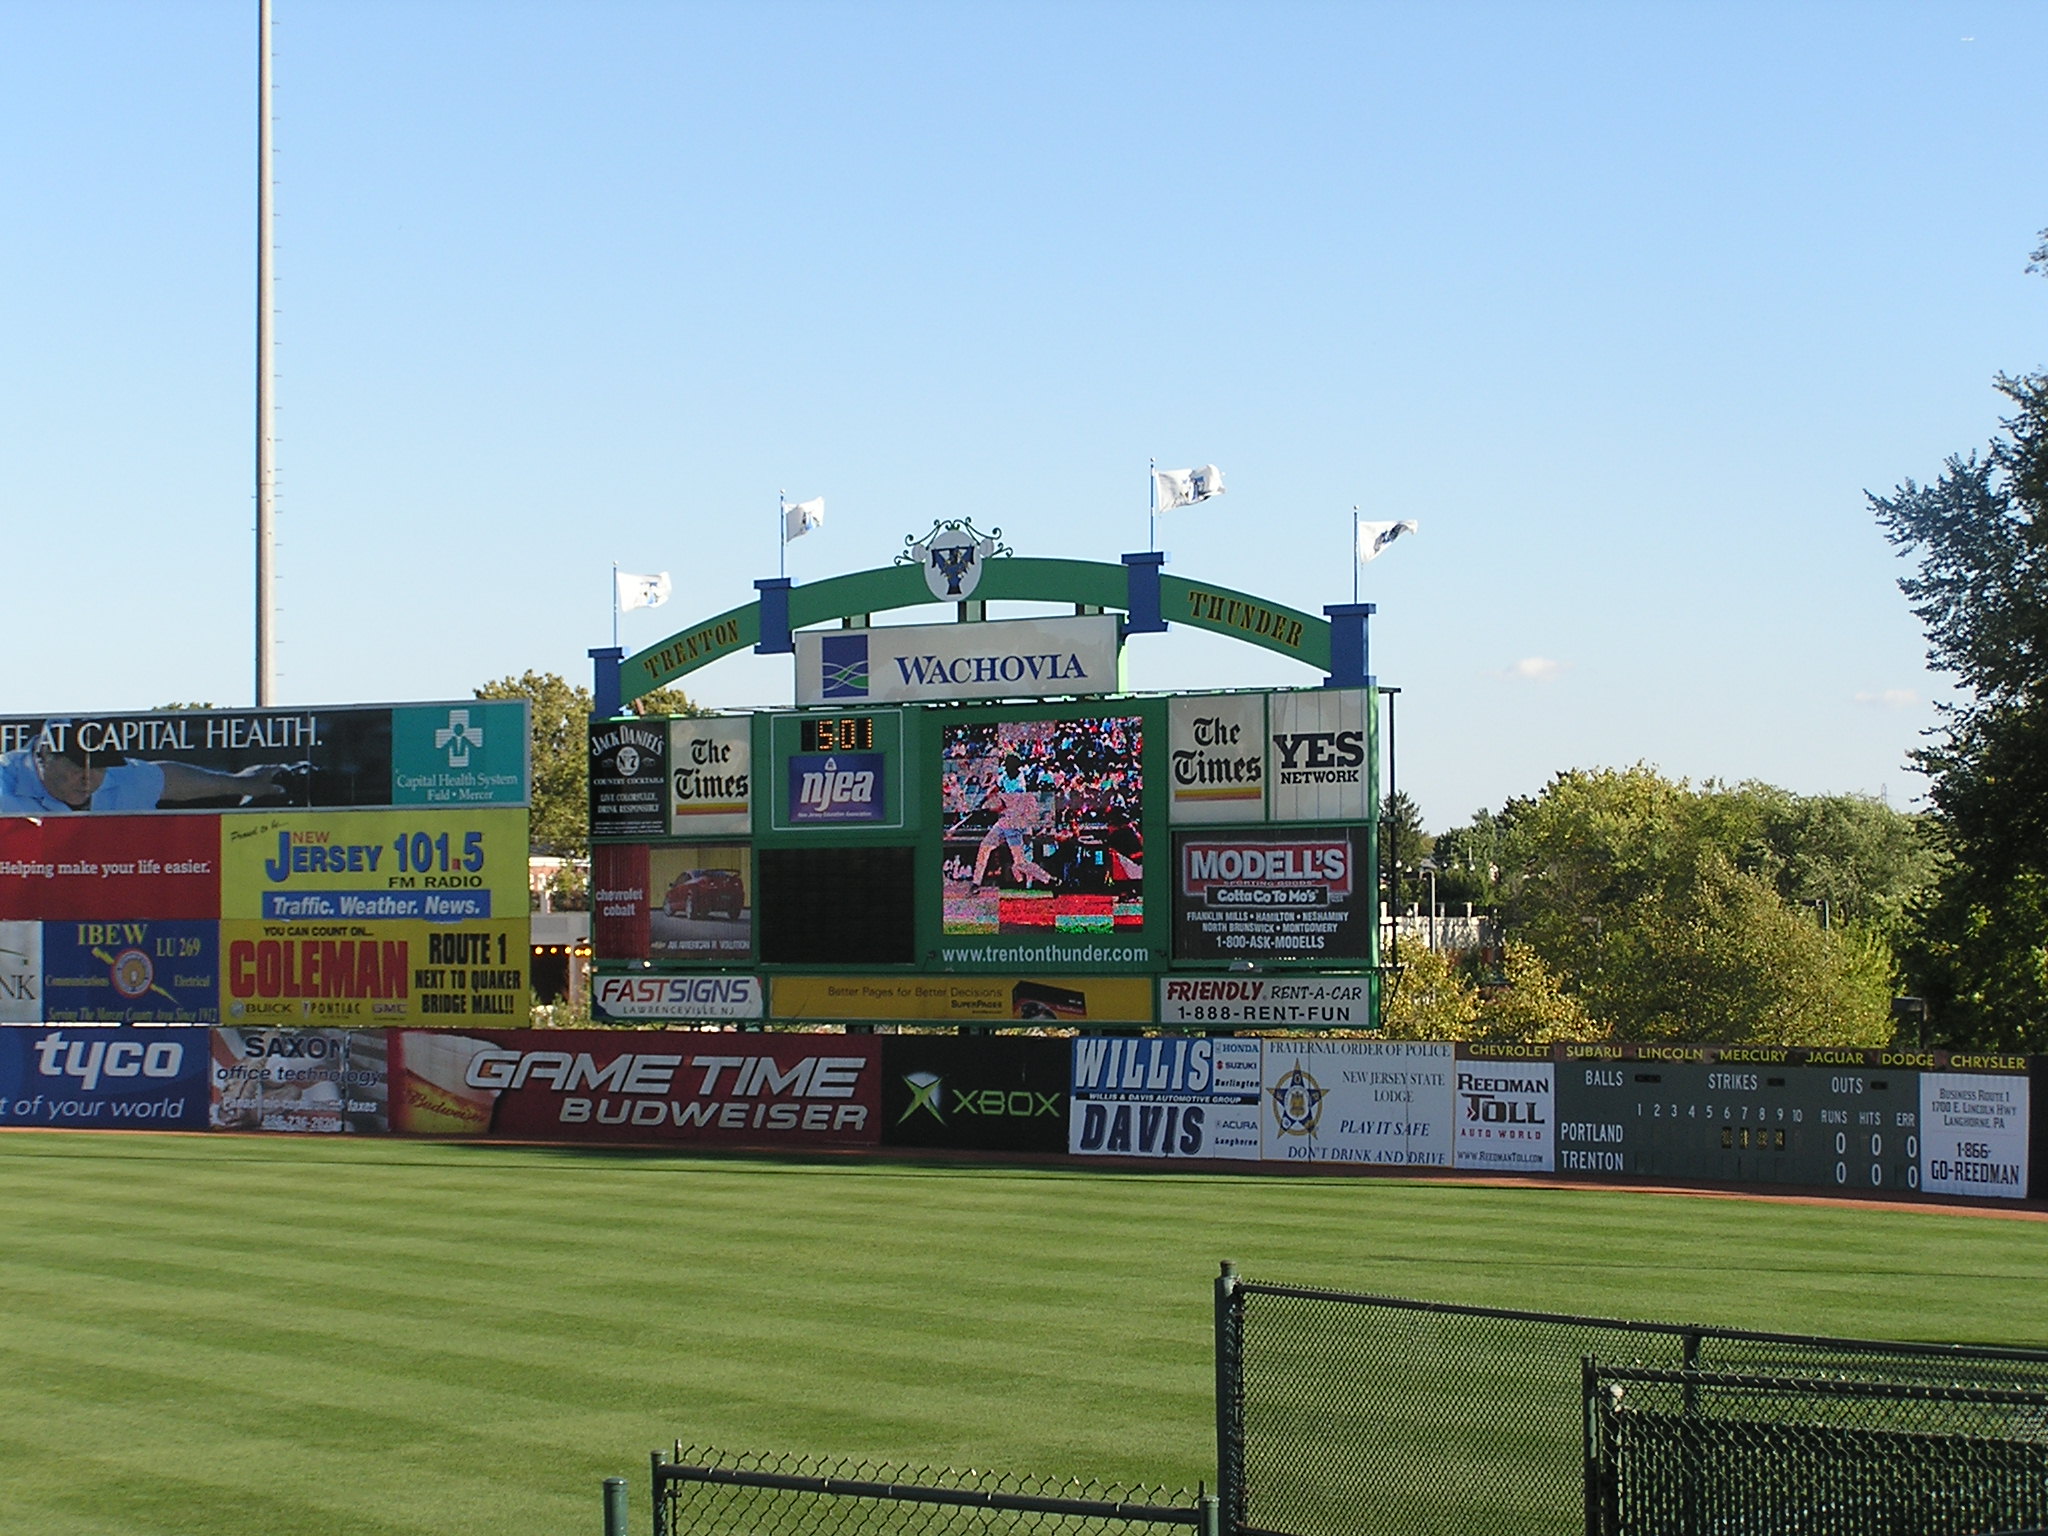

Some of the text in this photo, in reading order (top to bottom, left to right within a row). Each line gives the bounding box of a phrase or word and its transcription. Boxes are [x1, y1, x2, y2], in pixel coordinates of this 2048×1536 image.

[1188, 588, 1304, 649] THUNDER
[643, 618, 739, 680] TRENTON
[894, 653, 1088, 685] WACHOVIA
[36, 716, 323, 752] AT CAPITAL HEALTH.
[1193, 717, 1241, 746] The
[591, 731, 620, 756] JACK
[691, 738, 731, 765] The
[1272, 731, 1365, 769] YES
[1173, 750, 1262, 785] Times
[397, 772, 518, 791] Capital Health System
[674, 767, 748, 799] Times
[800, 757, 875, 812] njea
[1280, 769, 1360, 785] NETWORK
[458, 788, 493, 800] Mercer
[292, 831, 331, 844] NEW
[265, 831, 485, 883] JERSEY 101.5
[1190, 848, 1346, 881] MODELL'S
[0, 860, 55, 879] Helping
[58, 859, 99, 875] make
[101, 861, 136, 879] your
[138, 858, 161, 875] life
[388, 875, 483, 889] FM RADIO
[595, 887, 644, 902] chevrolet
[1216, 889, 1253, 903] Gotta
[1253, 889, 1271, 903] Go
[1271, 889, 1287, 903] To
[1288, 889, 1317, 903] Mo's
[272, 893, 480, 916] Traffic. Weather. News.
[603, 903, 637, 917] cobalt
[1187, 911, 1349, 922] FRANKLIN MILLS HAMILTON NESHAMINY
[77, 924, 149, 946] IBEW
[263, 926, 349, 937] YOU CAN COUNT
[1202, 922, 1338, 933] NORTH BRUNSWICK MONTGOMERY
[156, 937, 201, 957] LU 269
[428, 933, 507, 965] ROUTE 1
[1215, 936, 1325, 949] 1-800-ASK-MODELLS
[942, 945, 1149, 963] www.trentonthunder.com
[229, 939, 409, 999] COLEMAN
[415, 969, 521, 993] NEXT TO QUAKER
[601, 979, 750, 1003] FASTSIGNS
[828, 985, 1003, 1000] Better Pages for Better Decisions
[1167, 981, 1362, 1001] FRIENDLY RENT-A-CAR
[245, 1002, 409, 1015] BUICK PONTIAC GMC
[421, 994, 467, 1014] BRIDGE
[720, 1005, 735, 1015] NJ
[1177, 1006, 1350, 1022] 1-888-RENT-FUN
[245, 1035, 351, 1060] SAXON
[1222, 1043, 1259, 1053] HONDA
[1270, 1041, 1450, 1057] FRATERNAL ORDER OF POLICE
[1469, 1044, 1551, 1058] CHEVROLET
[1566, 1046, 1623, 1059] SUBARU
[1637, 1047, 1704, 1060] LINCOLN
[1720, 1049, 1788, 1062] MERCURY
[34, 1031, 184, 1091] tyco
[1075, 1039, 1212, 1092] WILLIS
[1225, 1062, 1257, 1070] SUZUKI
[1805, 1051, 1865, 1065] JAGUAR
[1881, 1053, 1936, 1067] DODGE
[1951, 1055, 2026, 1070] CHRYSLER
[216, 1065, 385, 1088] office technology
[464, 1049, 867, 1098] GAME TIME
[1343, 1071, 1445, 1086] NEW JERSEY STATE
[1585, 1070, 1624, 1087] BALLS
[1708, 1073, 1758, 1091] STRIKES
[1214, 1078, 1260, 1089] Burlington
[1457, 1073, 1550, 1094] REEDMAN
[1831, 1076, 1864, 1094] OUTS
[347, 1098, 378, 1112] faxes
[952, 1089, 1061, 1118] XBOX
[1089, 1093, 1242, 1104] WILLIS DAVIS AUTOMOTIVE GROUP
[1374, 1089, 1414, 1103] LODGE
[14, 1094, 184, 1121] of your world
[558, 1098, 869, 1132] BUDWEISER
[1461, 1092, 1546, 1125] TOLL
[1637, 1103, 1803, 1122] 1 2 3 4 5 6 7 8 9 10
[1222, 1120, 1258, 1130] ACURA
[1821, 1110, 1915, 1127] RUNS HITS ERR
[1993, 1117, 2005, 1129] PA
[1080, 1104, 1205, 1154] DAVIS
[1340, 1119, 1431, 1137] PLAY IT SAFE
[1461, 1127, 1543, 1141] AUTO WORLD
[1214, 1136, 1258, 1147] Langhorne
[1561, 1122, 1917, 1158] PORTLAND 0 0 0
[1288, 1146, 1445, 1165] DON'T DRINK AND DRIVE
[1561, 1150, 1918, 1188] TRENTON 0 0 0
[1931, 1159, 2019, 1185] GO-REEDMAN
